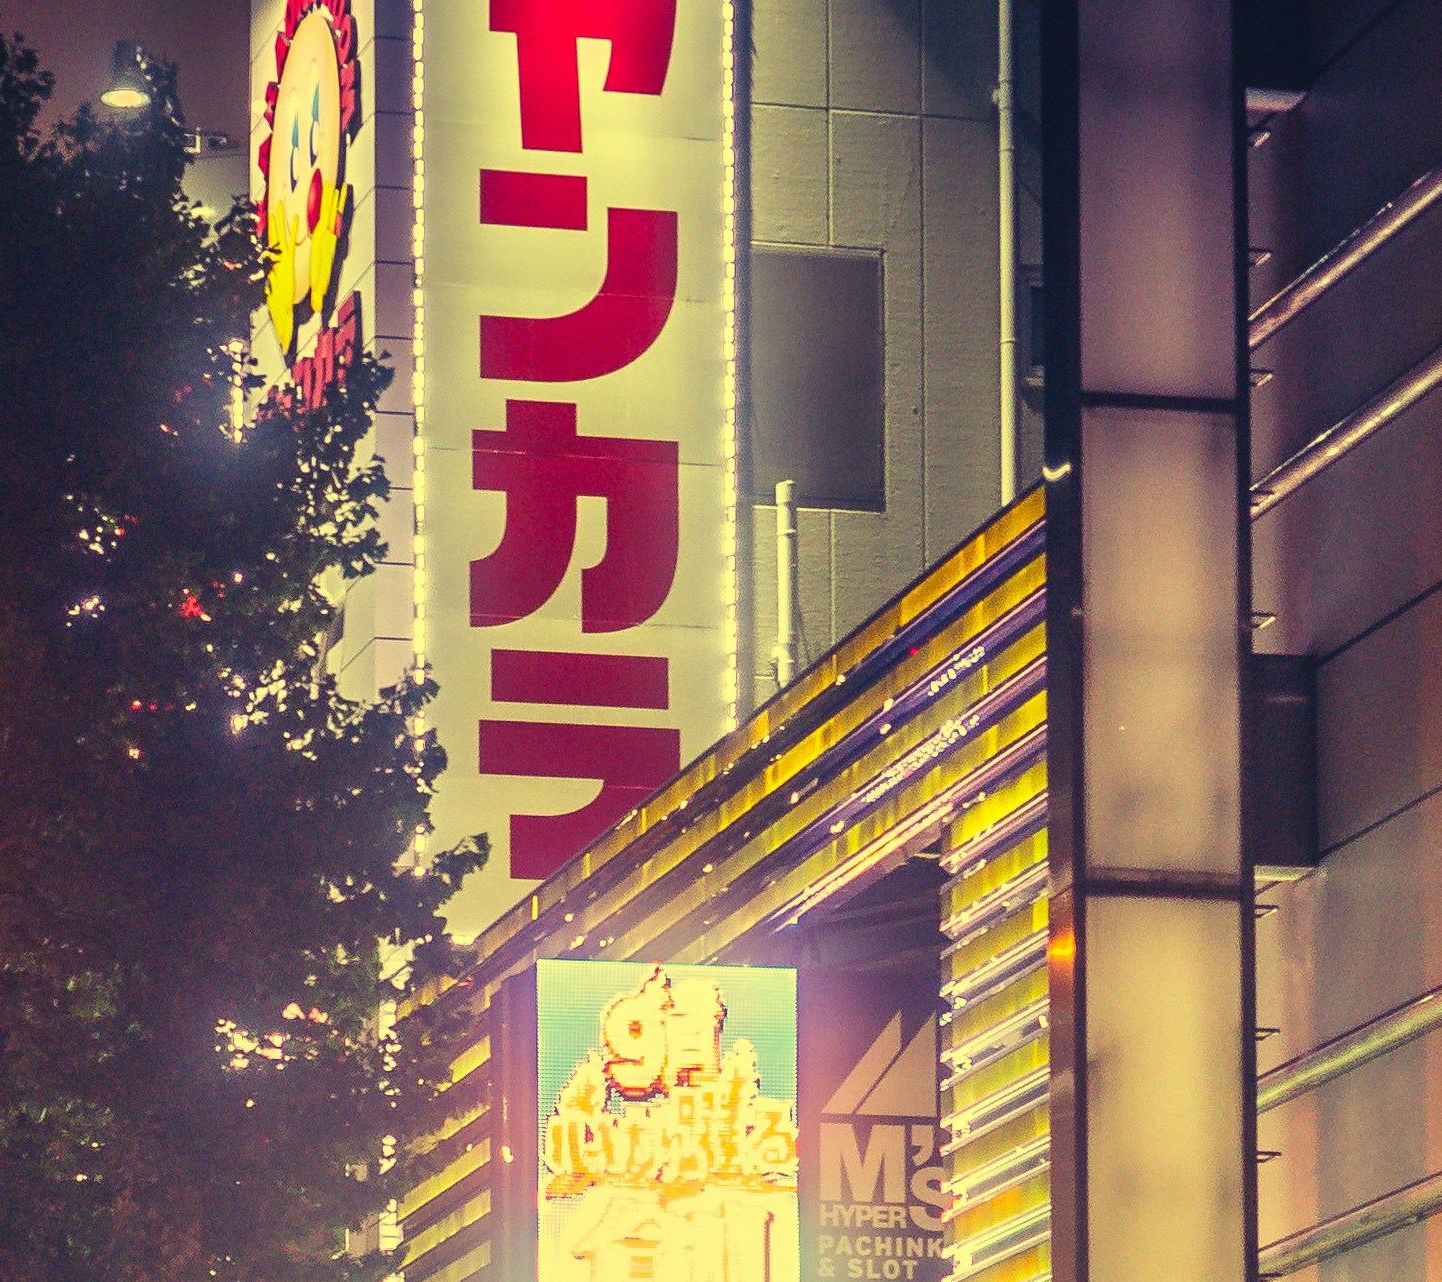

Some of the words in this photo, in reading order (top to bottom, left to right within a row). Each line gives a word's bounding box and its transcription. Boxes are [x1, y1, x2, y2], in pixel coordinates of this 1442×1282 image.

[818, 1203, 908, 1229] HYPER
[817, 1234, 943, 1258] PACHINK
[817, 1257, 835, 1279] &
[846, 1257, 919, 1281] SLOT
